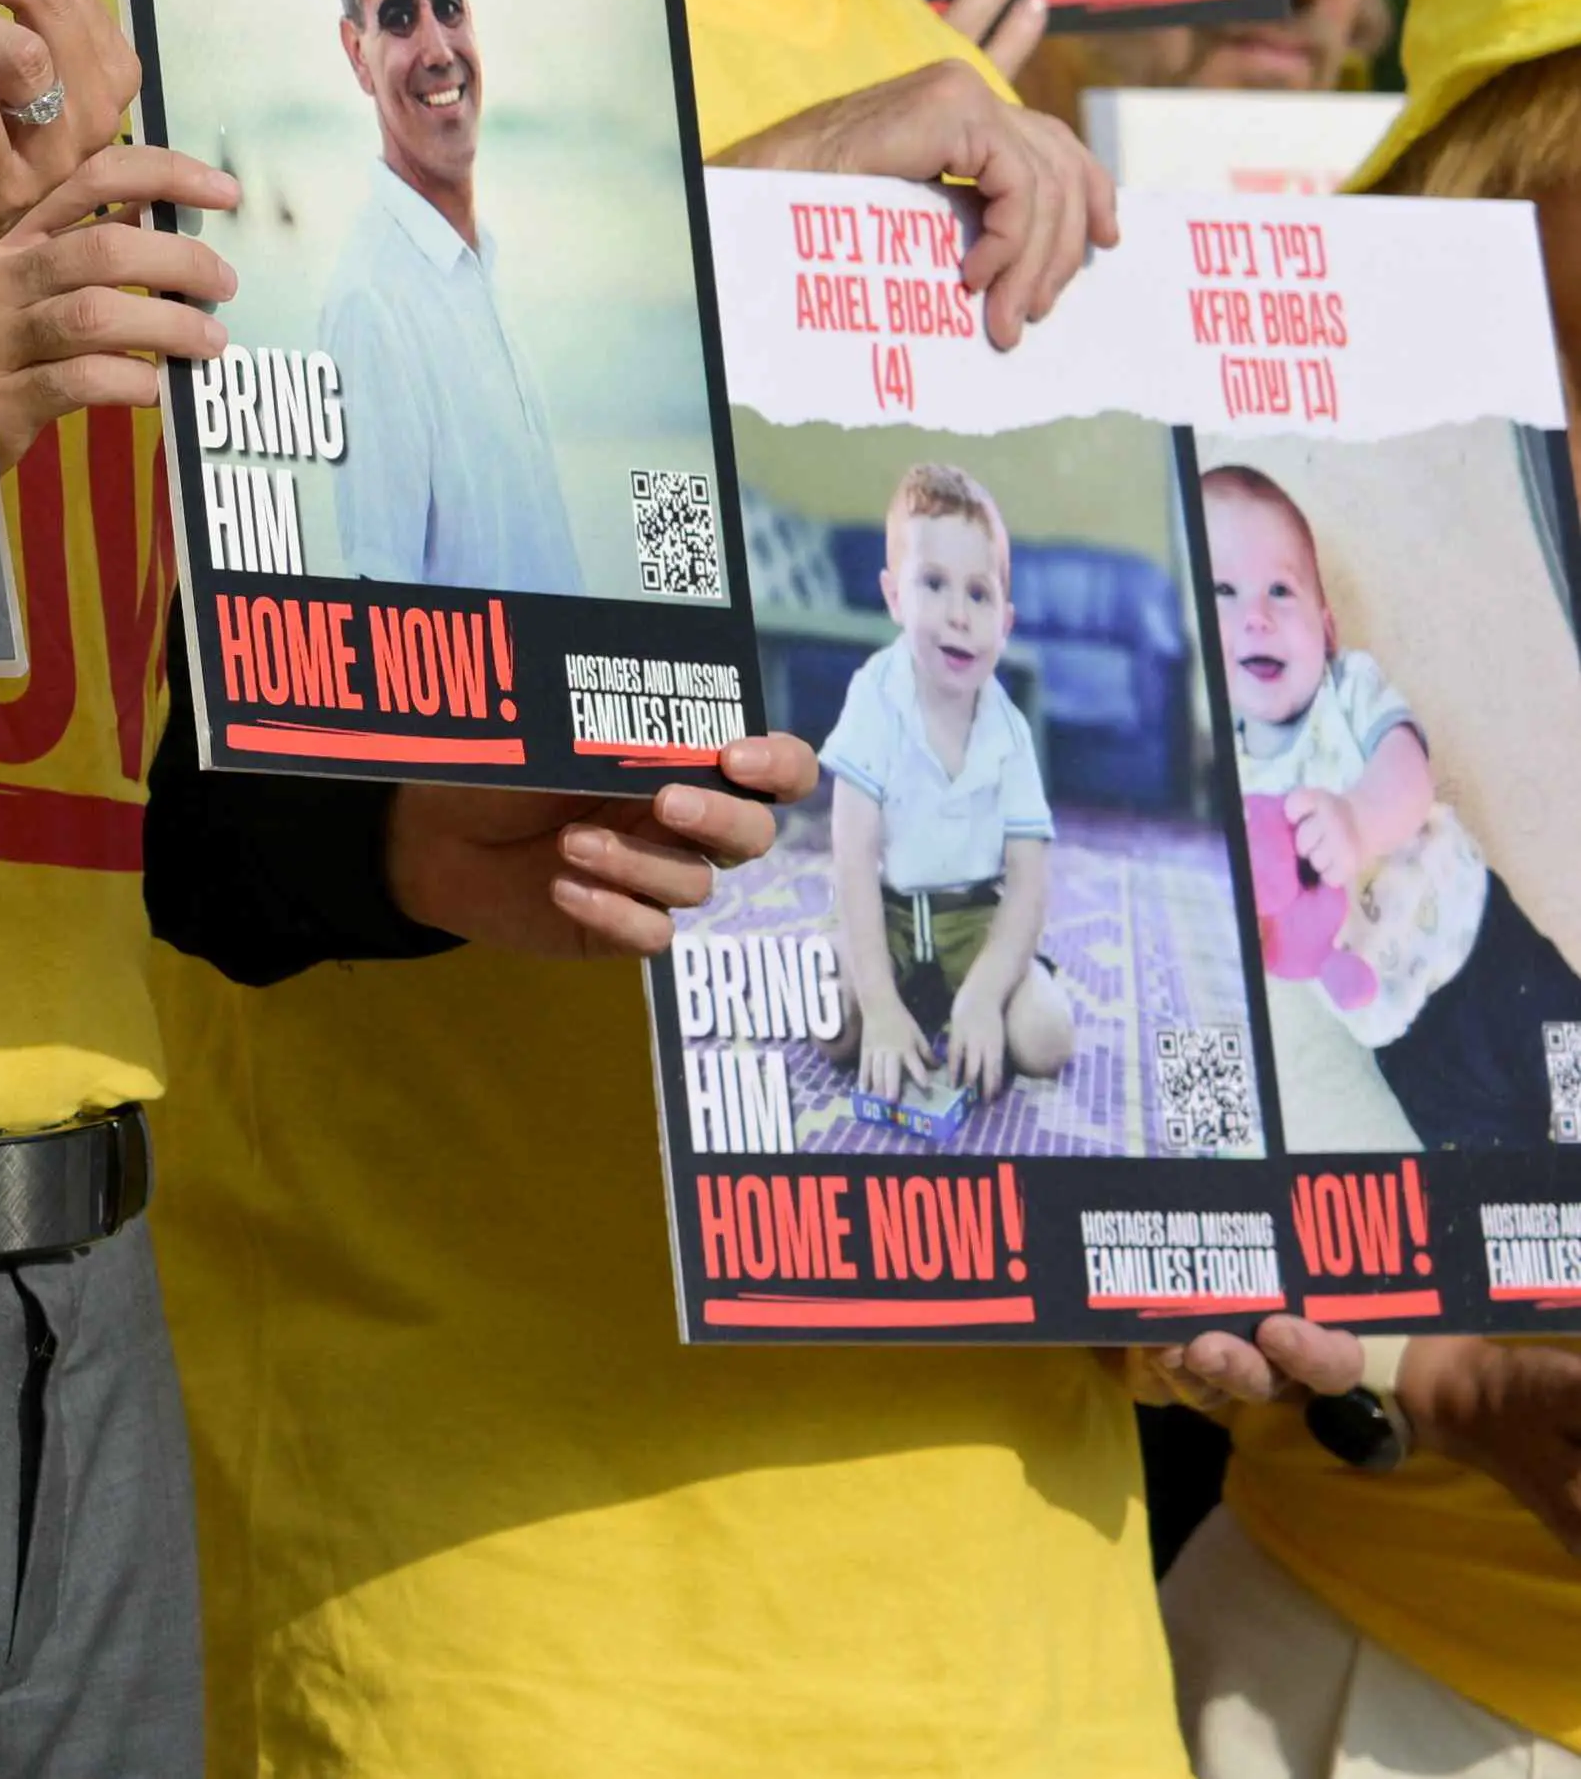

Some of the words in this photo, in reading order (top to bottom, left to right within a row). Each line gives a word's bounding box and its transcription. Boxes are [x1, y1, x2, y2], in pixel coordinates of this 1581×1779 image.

[790, 203, 863, 263] ביבס
[867, 203, 962, 269] אריאל
[1187, 220, 1259, 278] ביבס
[1260, 222, 1327, 280] כפיר
[796, 273, 880, 332] ARIEL
[884, 277, 975, 338] BIBAS
[1188, 289, 1256, 345] KFIR
[1259, 289, 1348, 348] BIBAS
[192, 343, 345, 460] BRING
[872, 342, 914, 412] (4)
[1222, 354, 1291, 419] שנה)
[1296, 356, 1337, 422] (בן
[202, 462, 304, 576] HIM
[215, 594, 363, 711] HOME
[369, 598, 517, 722] NOW!
[565, 653, 642, 694] HOSTAGES
[642, 659, 674, 696] AND
[674, 661, 740, 700] MISSING
[570, 692, 667, 747] FAMILIES
[671, 699, 746, 751] FORUM
[673, 933, 842, 1042] BRING
[687, 1048, 794, 1154] HIM
[697, 1174, 857, 1282] HOME
[866, 1162, 1026, 1284] NOW!
[1081, 1212, 1165, 1247] HOSTAGES
[1167, 1211, 1200, 1247] AND
[1202, 1211, 1273, 1246] MISSING
[1293, 1157, 1432, 1276] NOW!
[1480, 1203, 1559, 1239] HOSTAGES
[1086, 1248, 1194, 1296] FAMILIES
[1197, 1247, 1280, 1297] FORUM
